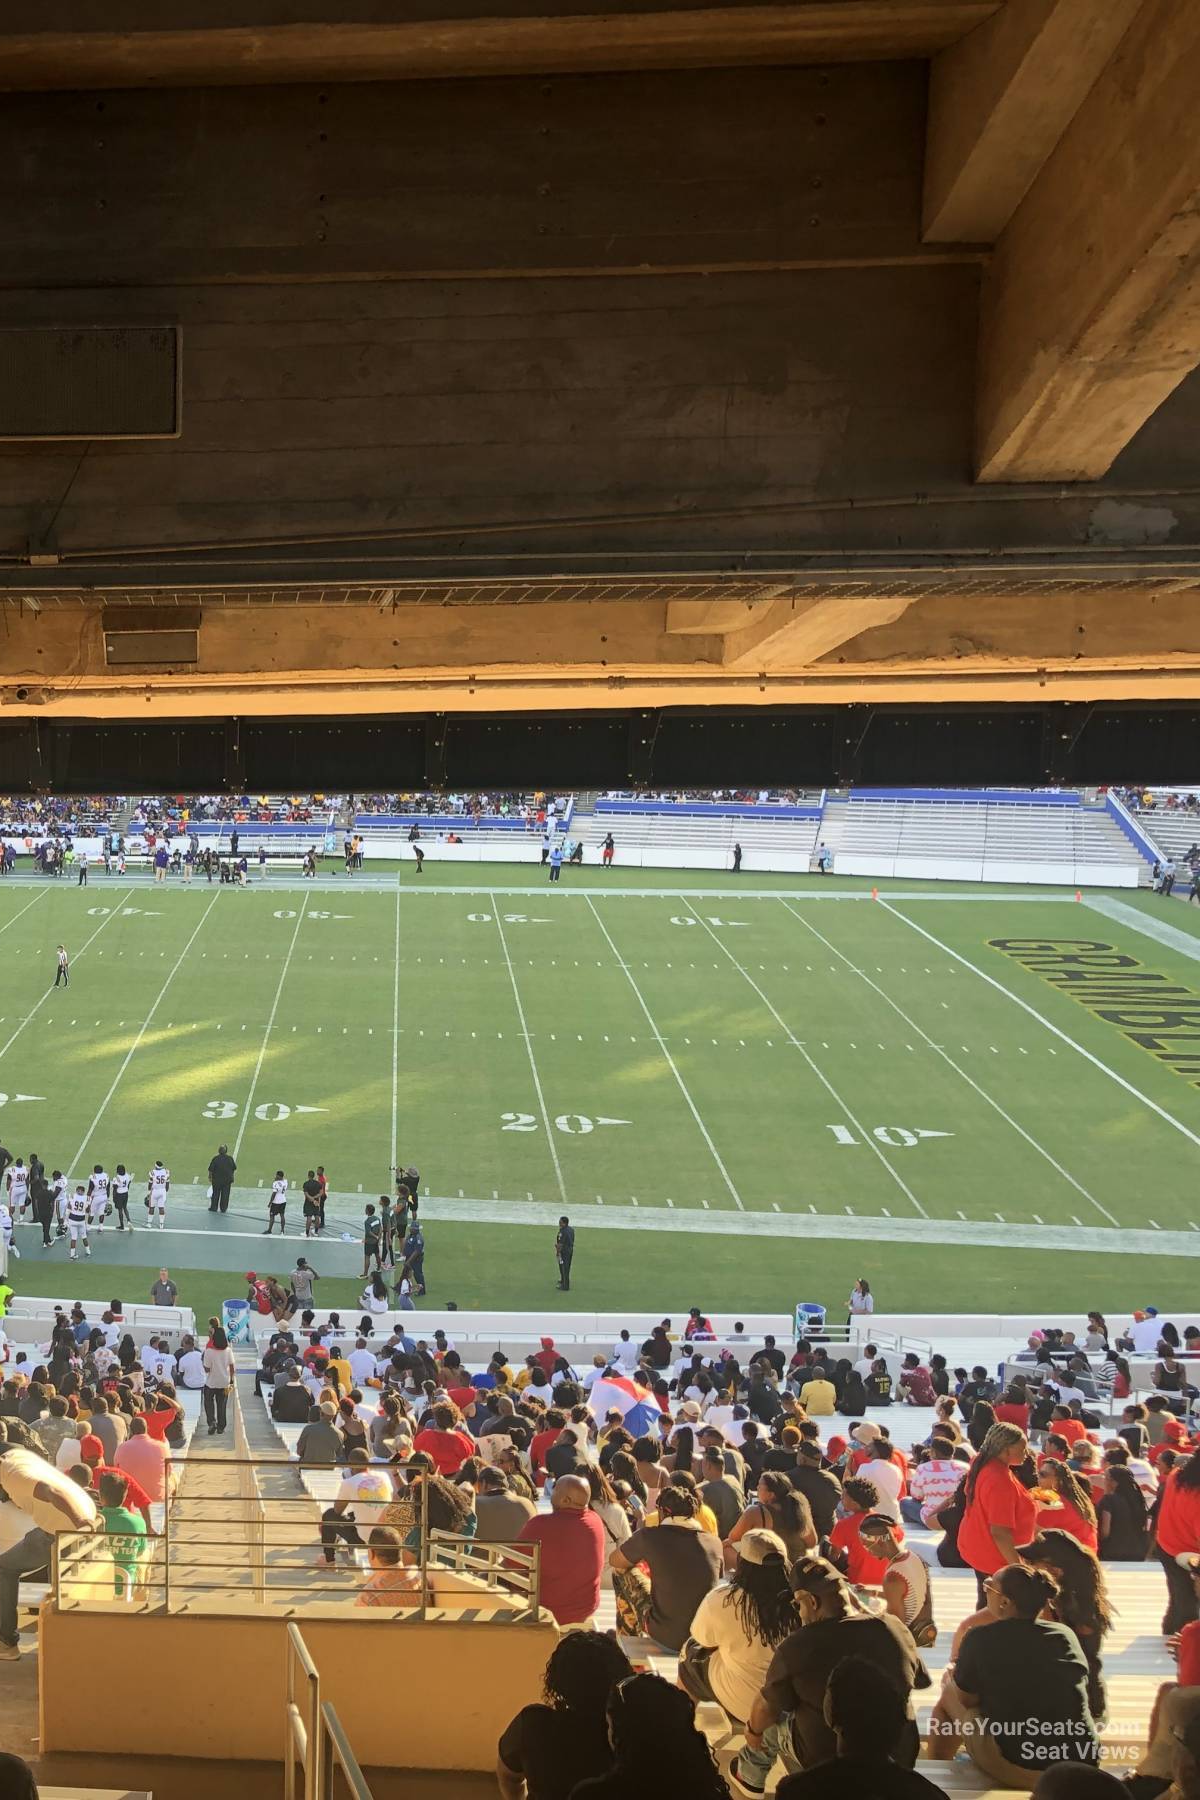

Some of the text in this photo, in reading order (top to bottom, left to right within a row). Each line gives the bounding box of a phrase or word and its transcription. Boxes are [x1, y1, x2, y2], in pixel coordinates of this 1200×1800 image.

[987, 938, 1200, 1087] GRAMBL
[201, 1100, 291, 1122] 30
[500, 1112, 595, 1134] 20
[825, 1124, 920, 1147] 10
[156, 1175, 166, 1185] 56
[74, 1201, 85, 1212] 99
[156, 1363, 164, 1376] 8
